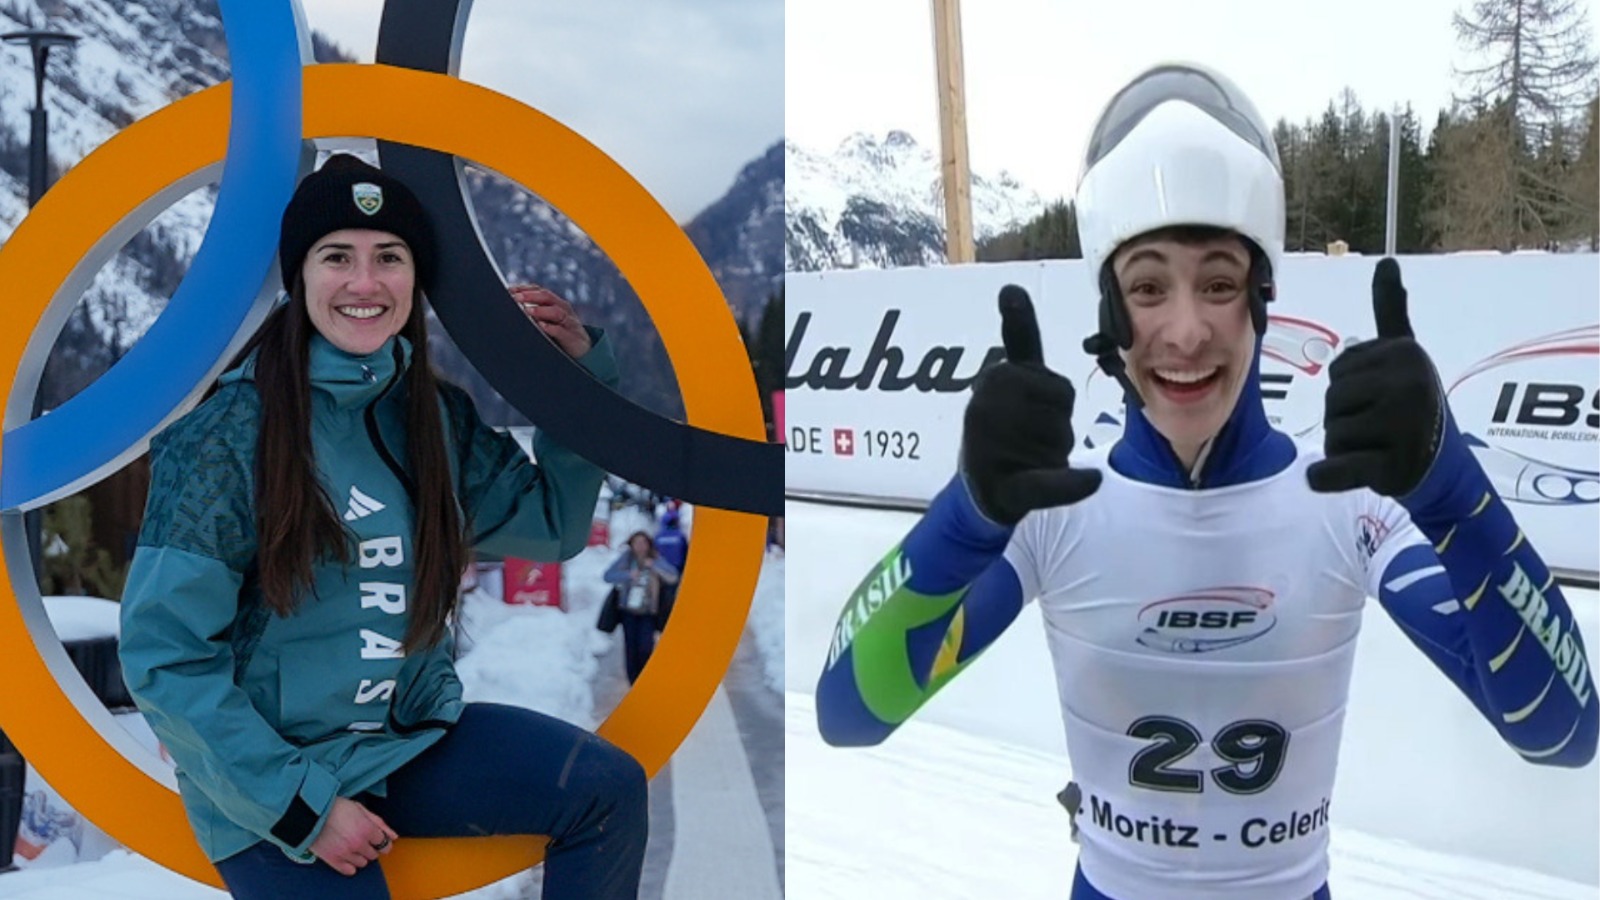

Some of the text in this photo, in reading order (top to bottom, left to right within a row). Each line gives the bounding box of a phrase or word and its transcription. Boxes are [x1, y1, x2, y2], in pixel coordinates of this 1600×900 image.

[1491, 382, 1599, 428] IB
[864, 429, 920, 459] 1932
[1157, 610, 1258, 628] IBSF
[1497, 560, 1591, 708] BRASIL
[1127, 715, 1291, 795] 29
[1090, 794, 1199, 848] Moritz
